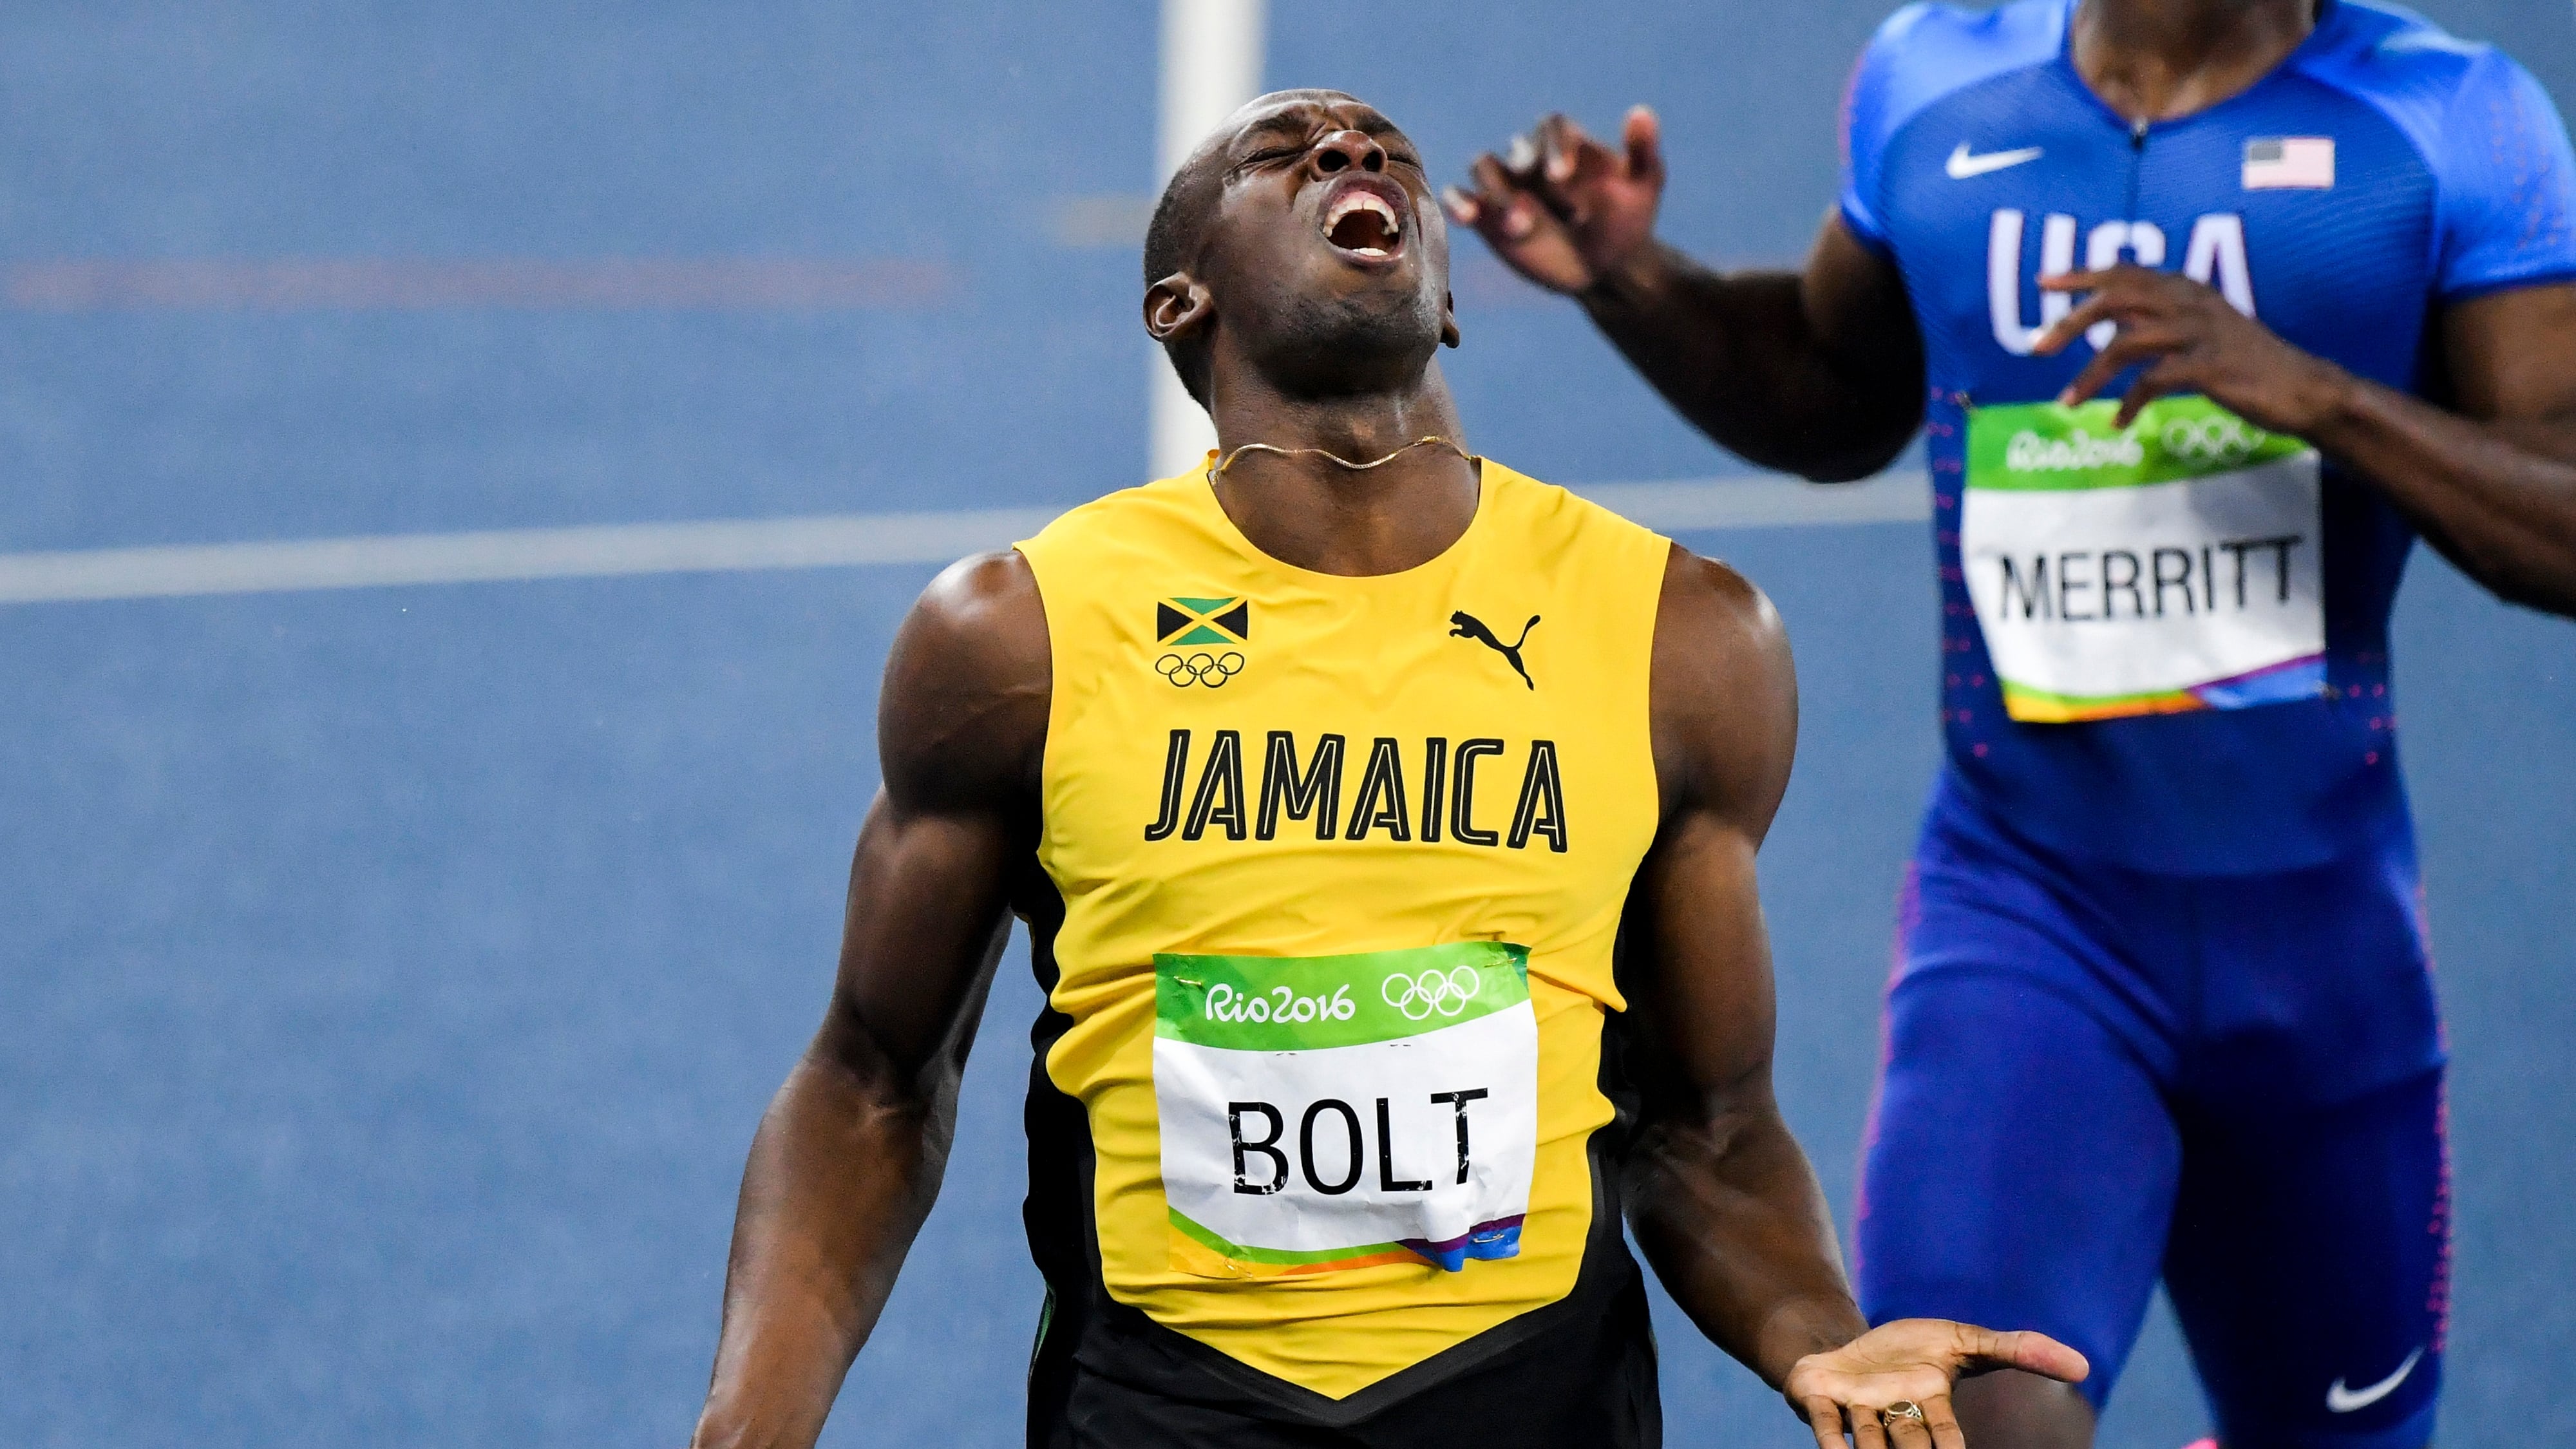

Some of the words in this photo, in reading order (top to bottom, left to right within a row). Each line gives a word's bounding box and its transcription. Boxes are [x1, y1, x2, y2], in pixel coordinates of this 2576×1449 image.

[1998, 535, 2304, 622] MERRITT
[1144, 729, 1567, 853] JAMAICA
[1205, 983, 1356, 1024] Rio2016
[1228, 1087, 1488, 1195] BOLT
